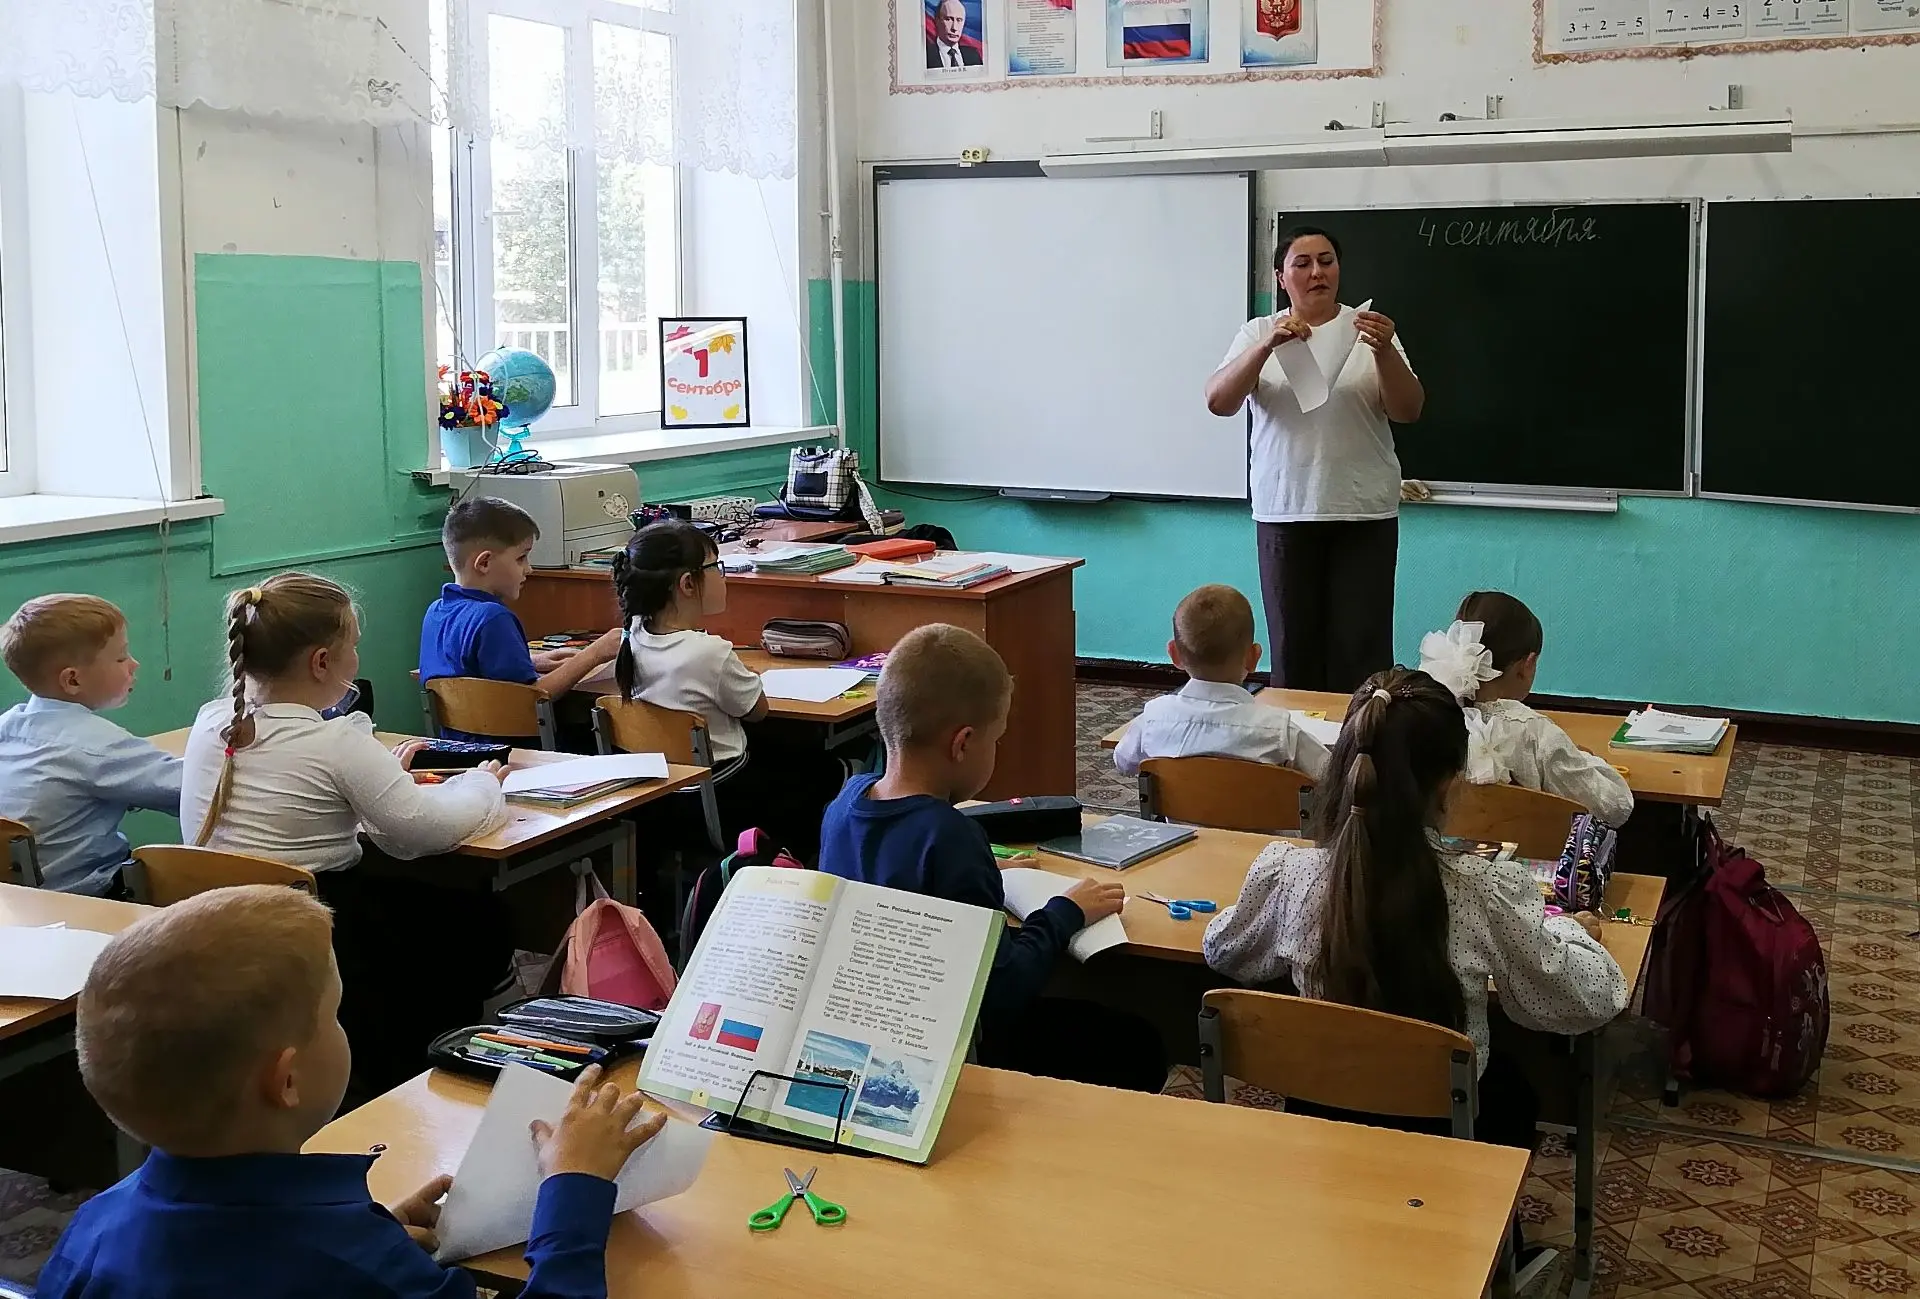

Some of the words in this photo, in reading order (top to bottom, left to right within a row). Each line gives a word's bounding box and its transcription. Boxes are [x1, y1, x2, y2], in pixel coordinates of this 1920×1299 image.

[1666, 10, 1674, 22] 7
[1703, 6, 1710, 20] 4
[1732, 5, 1740, 18] 3
[1569, 23, 1576, 33] 3
[1600, 20, 1606, 30] 2
[1636, 17, 1643, 27] 5
[1419, 217, 1436, 246] 4
[694, 349, 708, 377] 1
